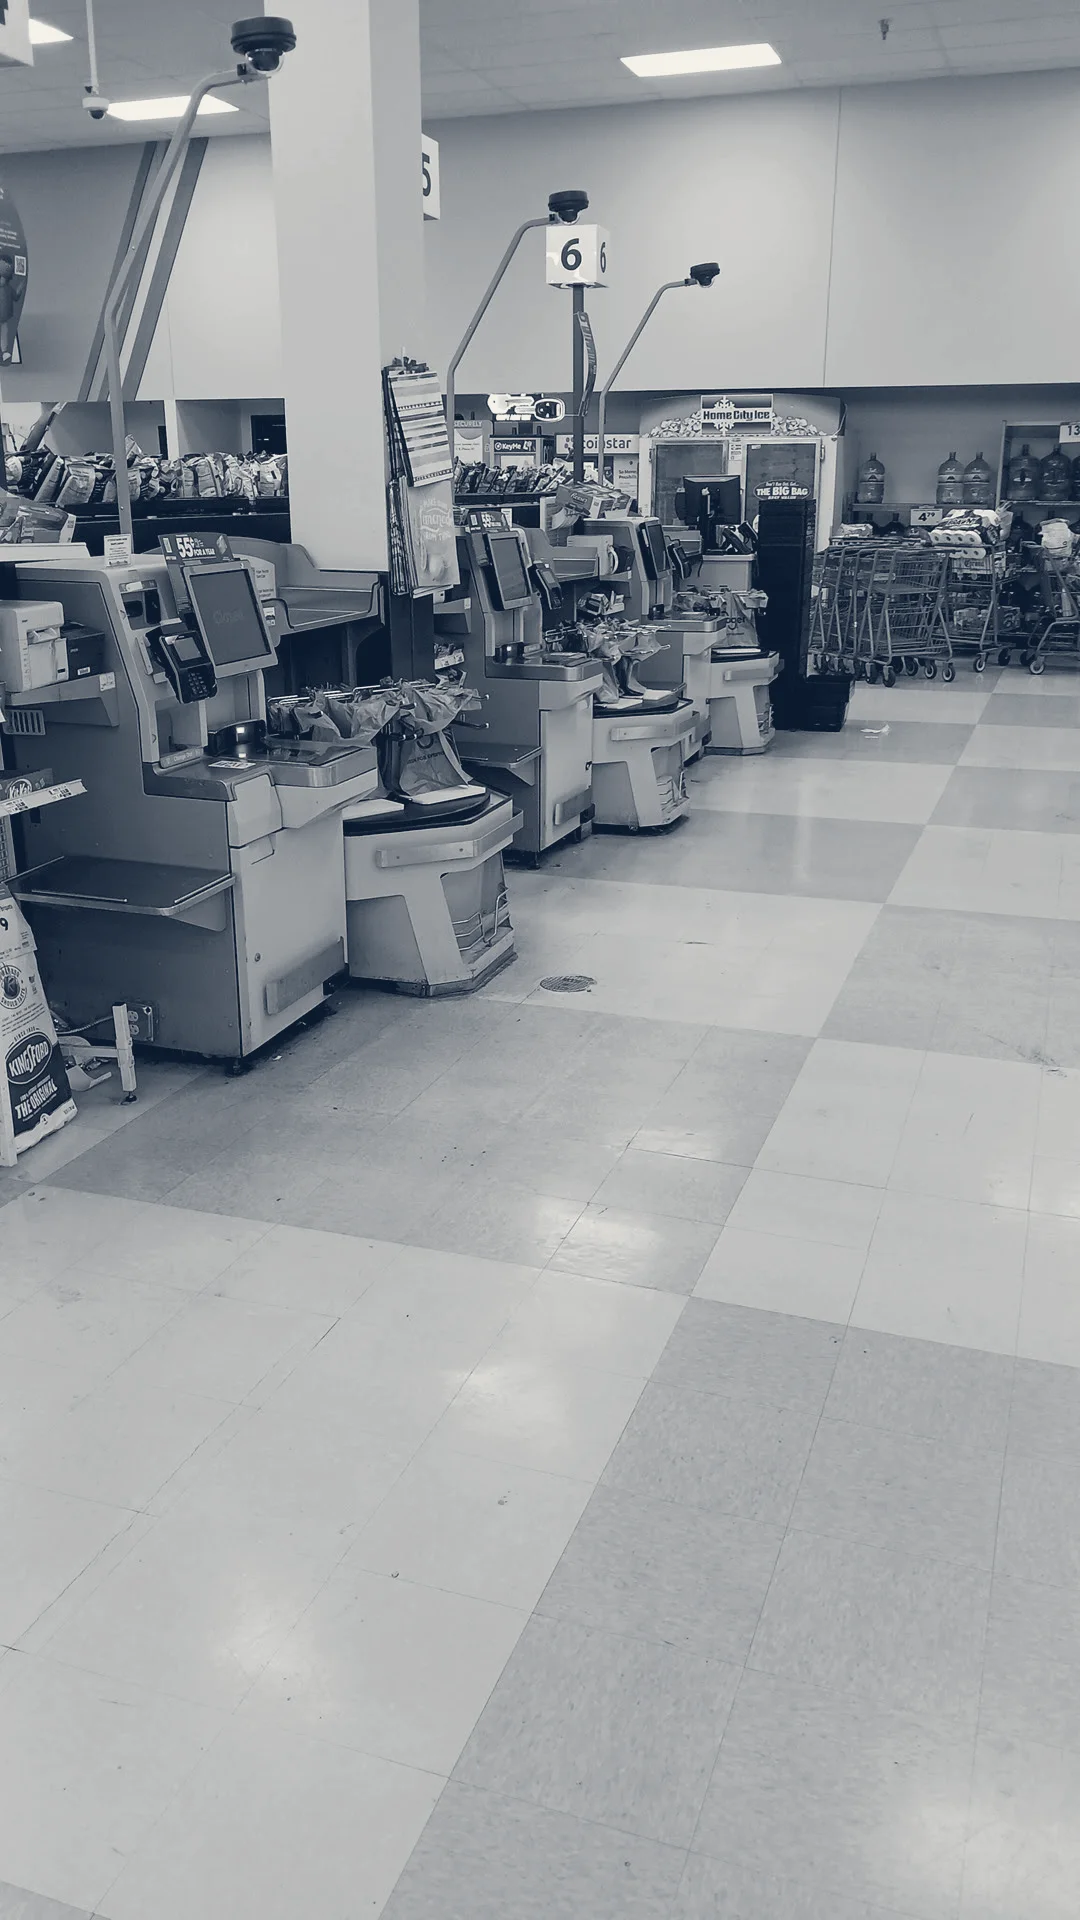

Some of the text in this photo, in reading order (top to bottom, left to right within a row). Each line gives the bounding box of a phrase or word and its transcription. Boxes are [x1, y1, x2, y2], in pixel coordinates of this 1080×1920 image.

[561, 238, 582, 270] 6
[600, 241, 606, 273] 6
[703, 410, 770, 421] Home City Ice
[502, 443, 522, 451] KeyMe
[583, 437, 631, 449] oistar
[756, 486, 808, 496] THE BIG BAG
[726, 617, 747, 630] oger
[8, 1041, 49, 1077] KINGSFORD
[15, 1102, 33, 1119] THE
[30, 1078, 58, 1110] ORIGINAL
